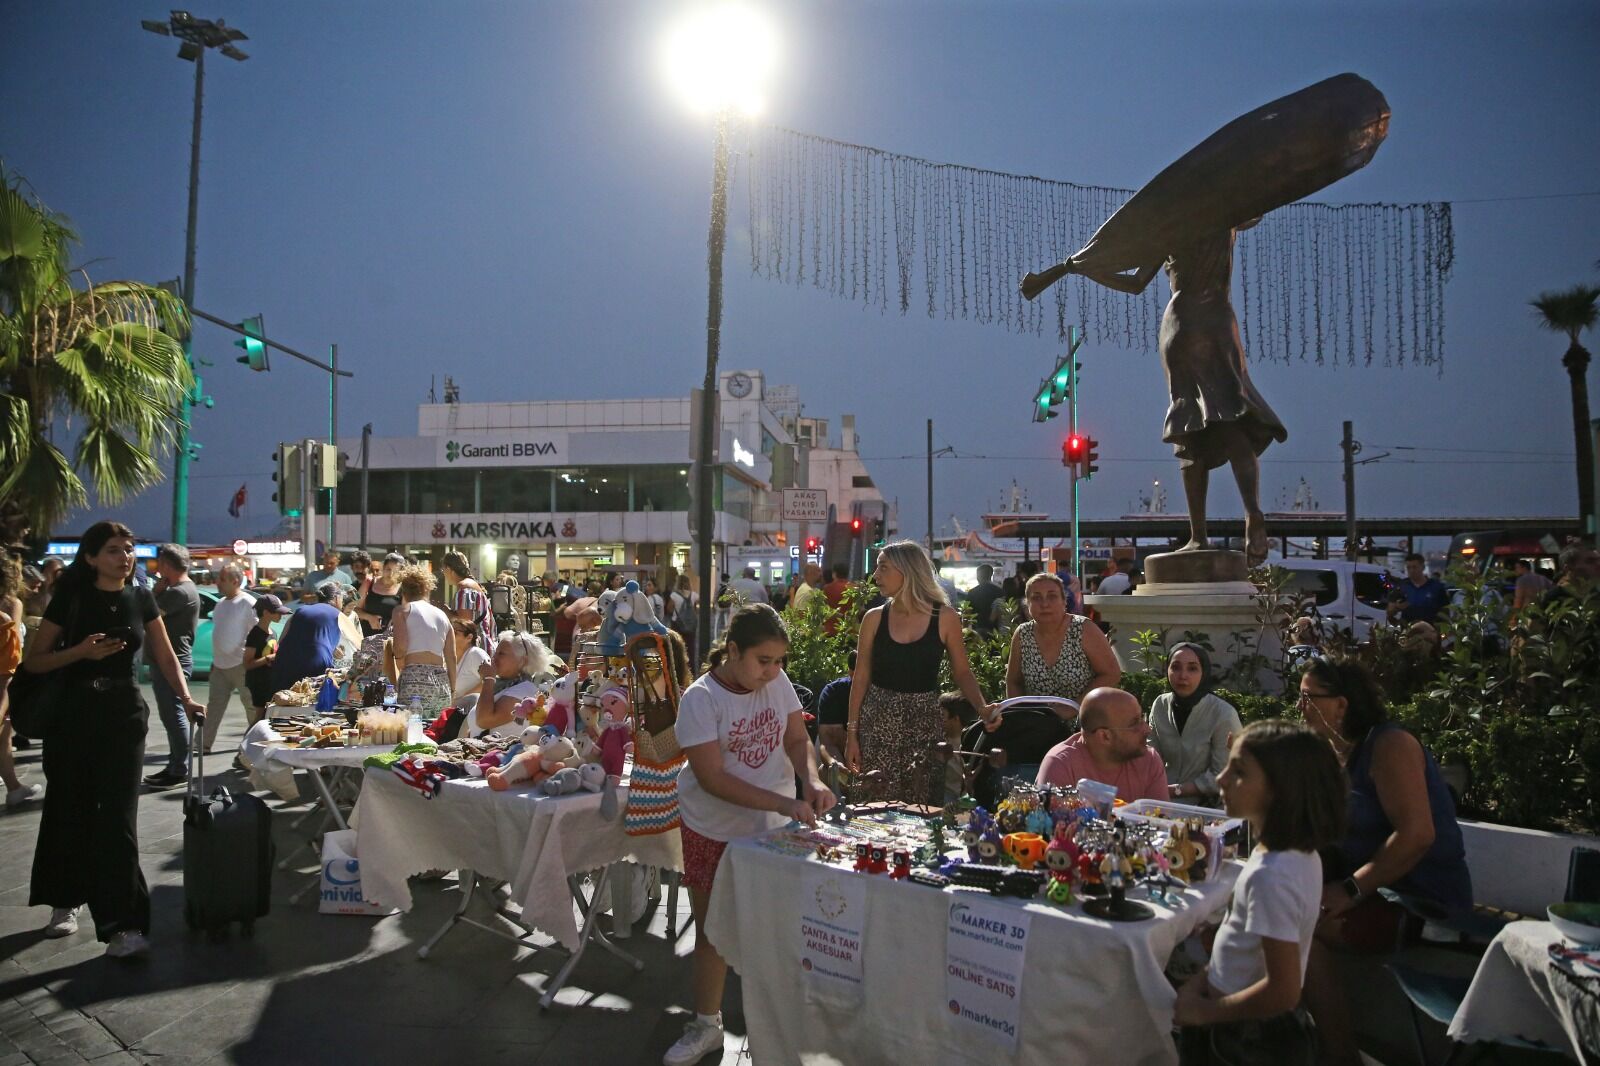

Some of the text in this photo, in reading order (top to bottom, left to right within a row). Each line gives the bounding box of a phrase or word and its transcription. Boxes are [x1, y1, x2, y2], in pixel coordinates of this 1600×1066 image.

[461, 441, 557, 458] Garanti BBVA
[792, 501, 818, 509] ÇIKIŞI
[794, 492, 817, 500] ARAÇ
[450, 521, 557, 540] KARŞIYAKA
[728, 707, 776, 737] Listen
[961, 912, 1026, 940] MARKER 3D
[801, 924, 829, 942] ÇANTA
[830, 933, 837, 945] &
[838, 936, 860, 951] TAKI
[949, 926, 1023, 951] www.marker3d.com
[806, 939, 853, 961] AKSESUAR
[986, 978, 1016, 999] SATIŞ
